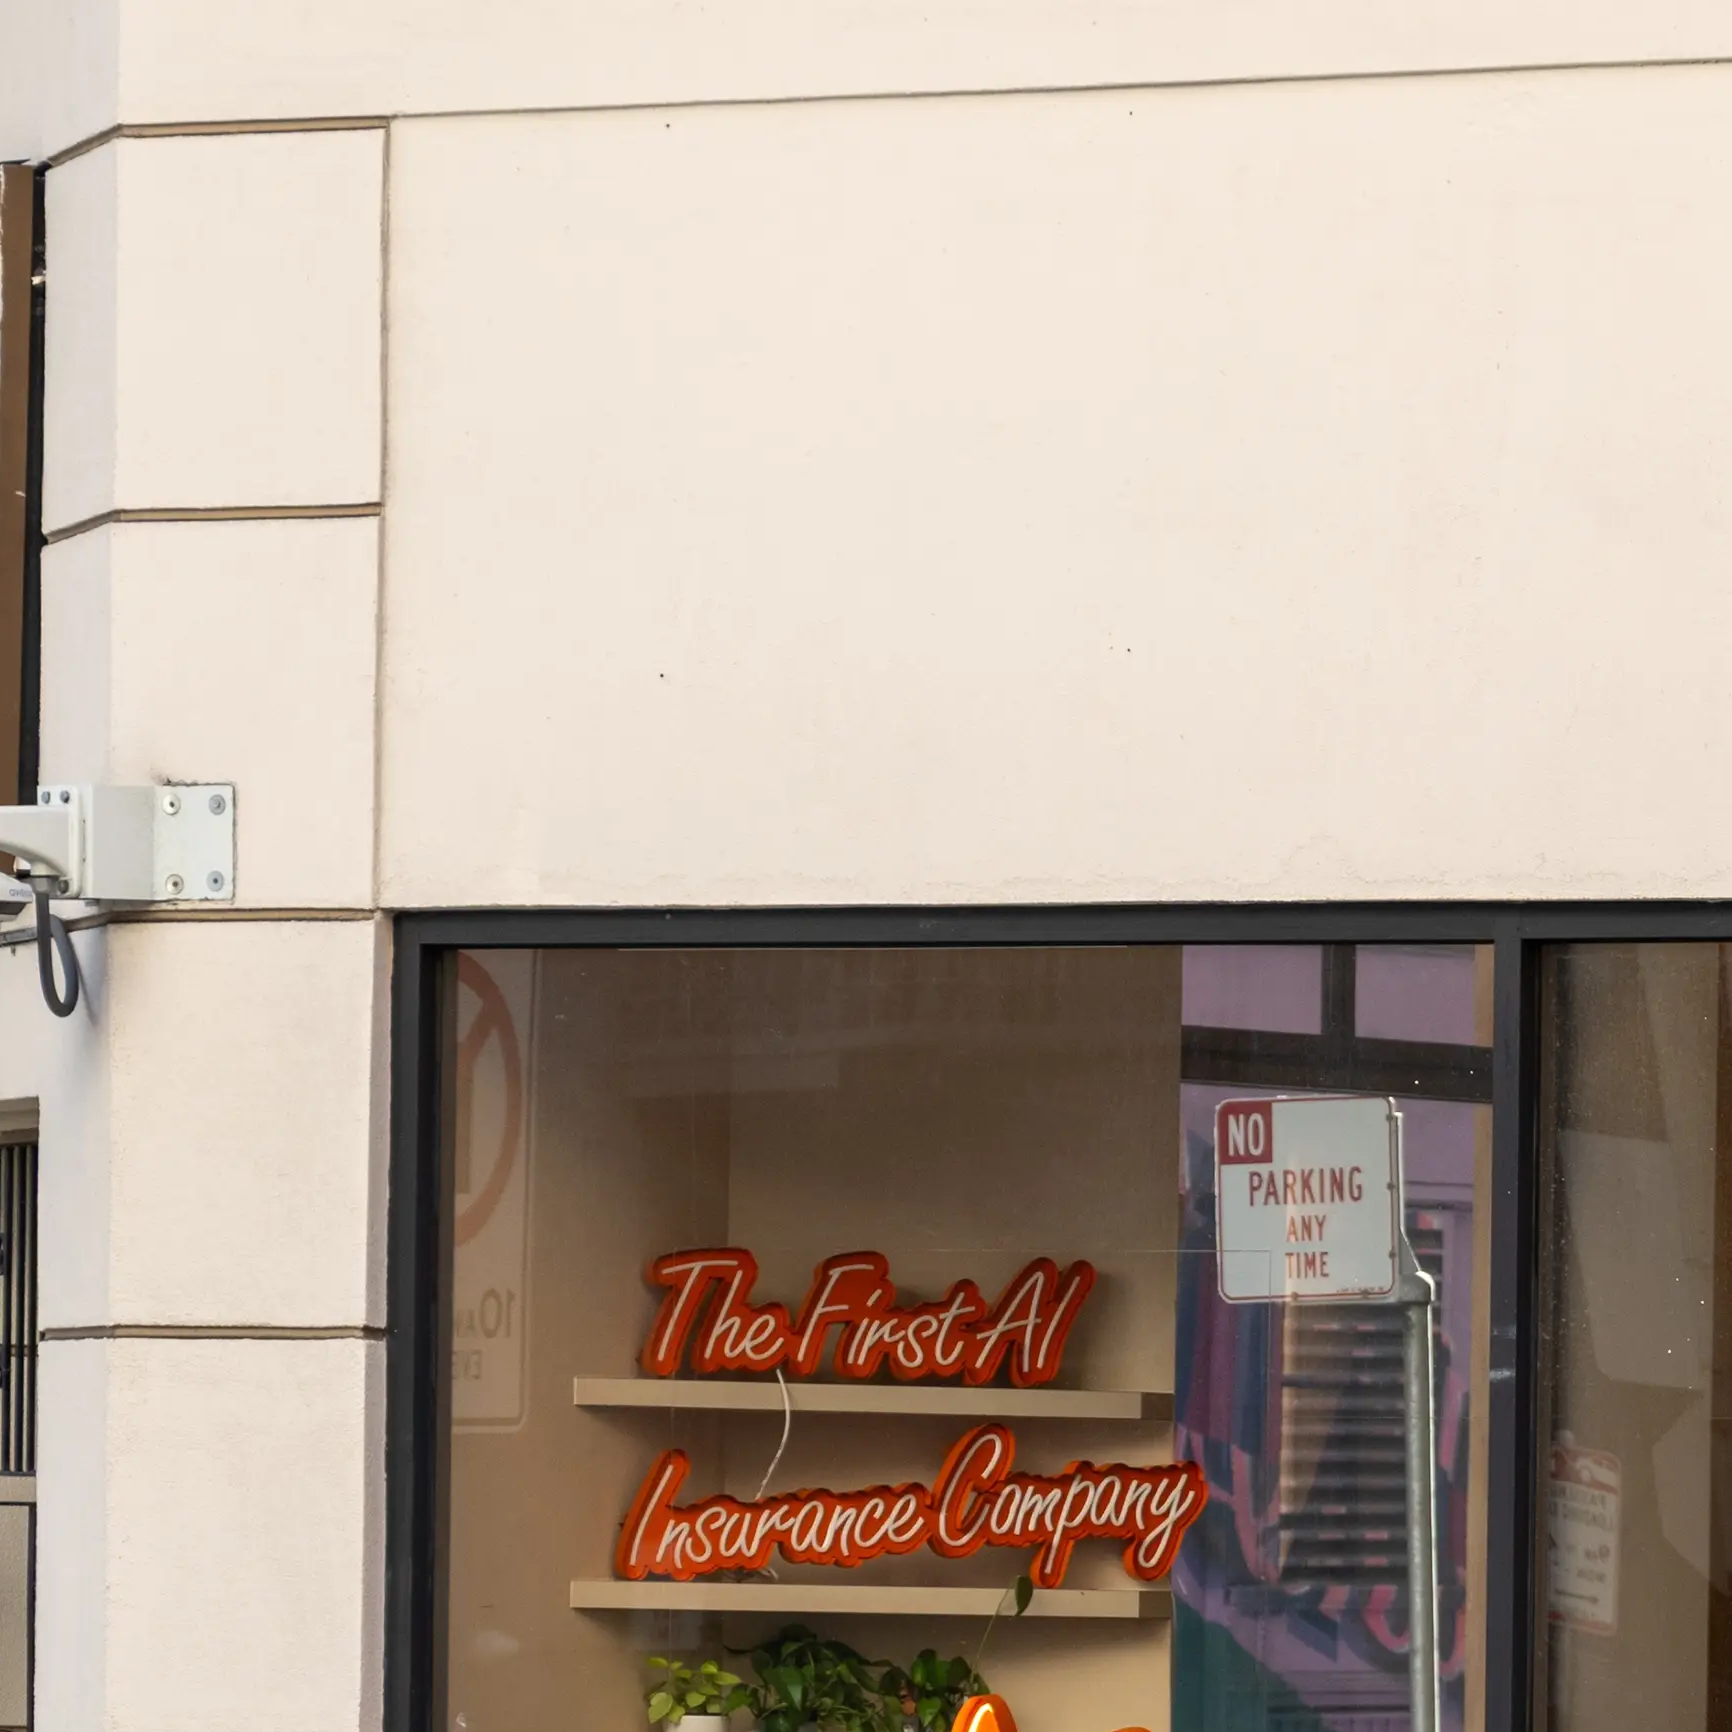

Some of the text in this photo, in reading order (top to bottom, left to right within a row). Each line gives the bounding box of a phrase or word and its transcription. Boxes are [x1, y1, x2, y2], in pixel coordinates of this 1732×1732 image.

[1227, 1113, 1264, 1156] NO
[1248, 1166, 1363, 1206] PARKING
[1286, 1215, 1326, 1242] ANY
[1285, 1252, 1329, 1278] TIME
[652, 1253, 1089, 1381] The First AI
[623, 1426, 1201, 1582] Insurance Company
